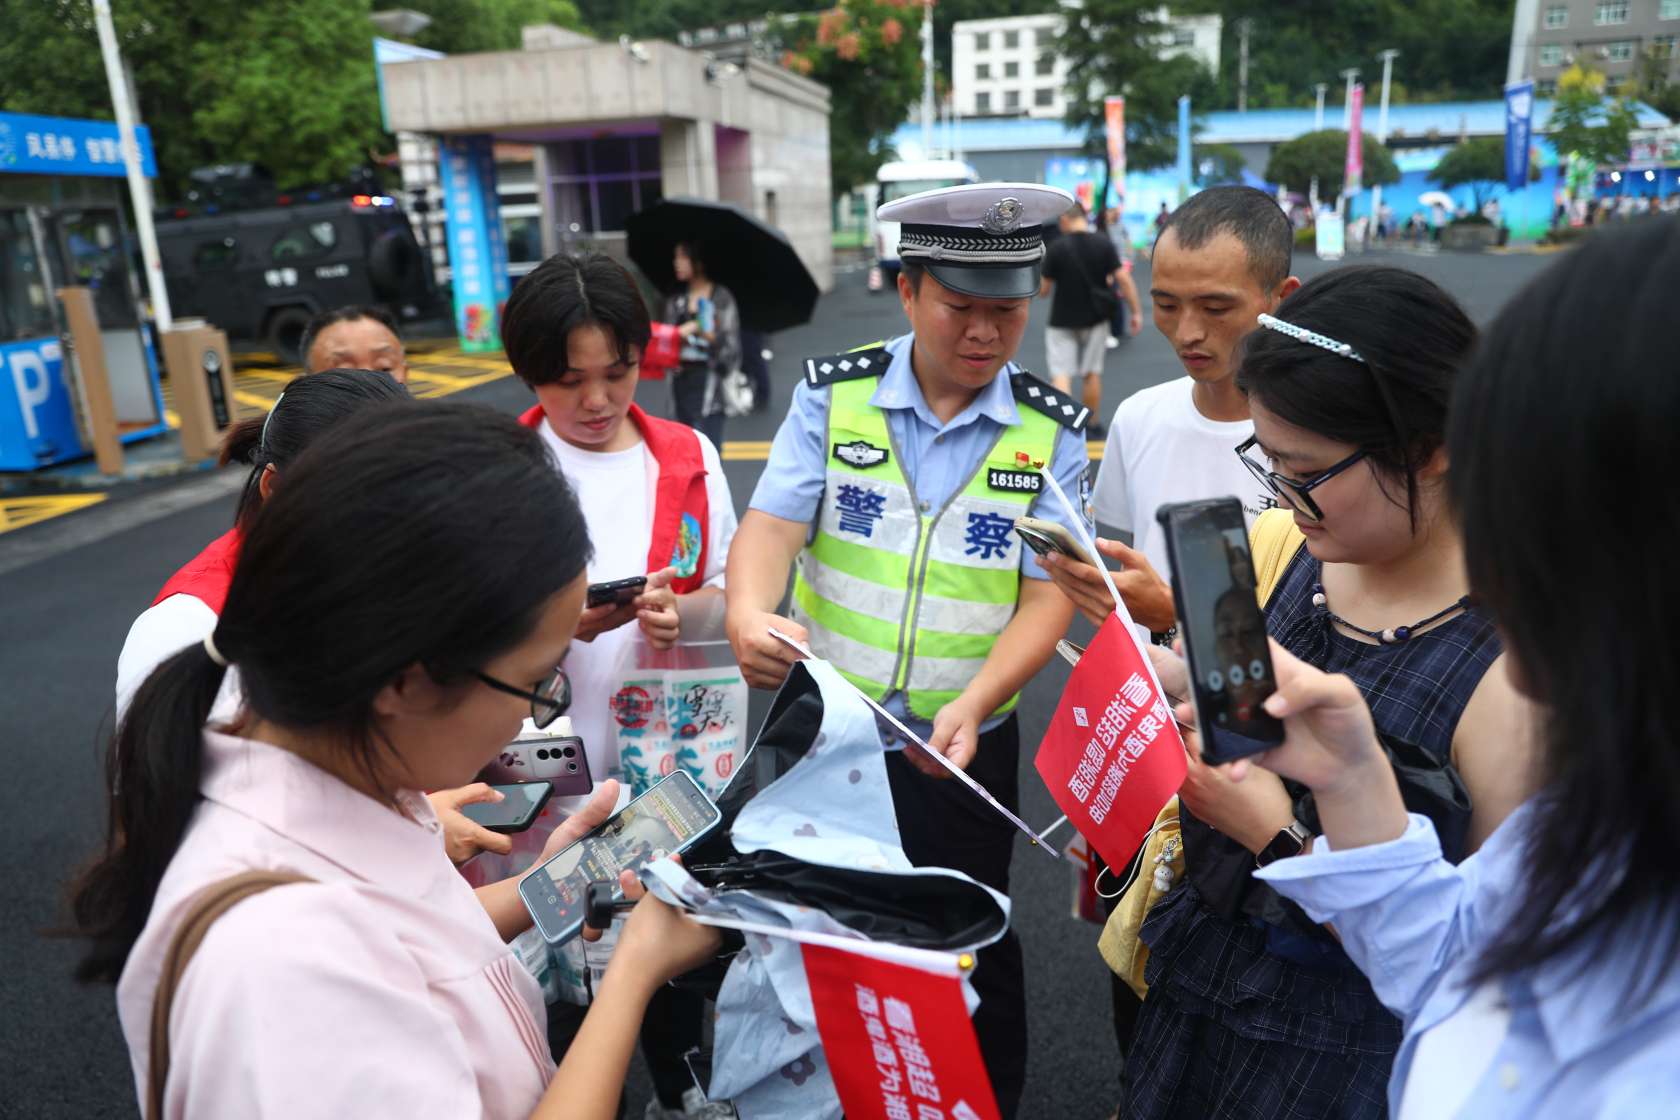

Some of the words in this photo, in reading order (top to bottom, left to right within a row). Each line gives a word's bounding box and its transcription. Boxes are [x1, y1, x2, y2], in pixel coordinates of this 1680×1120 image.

[8, 350, 51, 439] P
[990, 471, 1040, 490] 161585
[835, 484, 887, 538] 警
[965, 512, 1015, 560] 察
